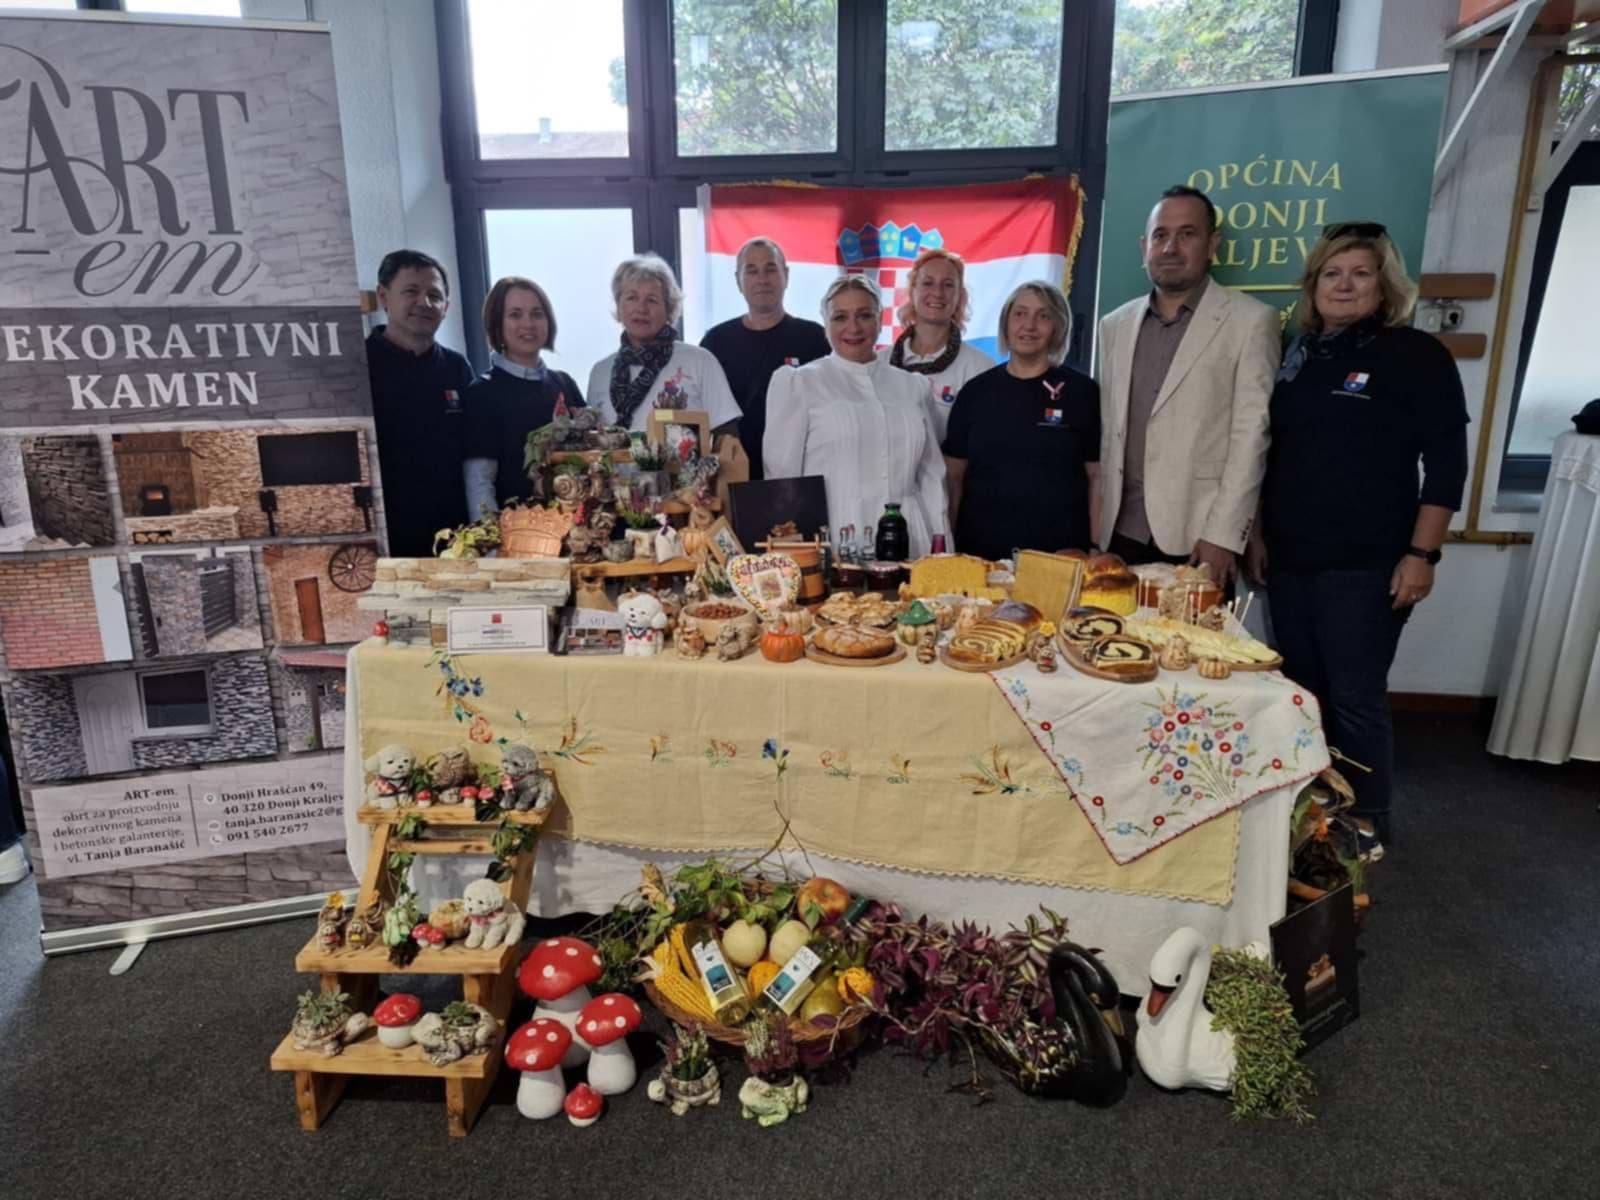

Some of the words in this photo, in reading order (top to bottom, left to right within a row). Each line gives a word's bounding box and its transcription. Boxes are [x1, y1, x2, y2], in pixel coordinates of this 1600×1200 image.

[1186, 153, 1344, 193] OPĆINA
[1, 321, 343, 362] EKORATIVNI
[66, 370, 259, 411] KAMEN
[221, 790, 255, 803] Donji
[257, 784, 306, 798] Hrašćan
[62, 811, 89, 823] obrt
[93, 810, 105, 819] za
[107, 801, 180, 819] proizvodnju
[223, 804, 239, 816] 40
[242, 802, 265, 813] 320
[268, 798, 301, 810] Donji
[52, 820, 134, 838] dekorativnog
[135, 815, 182, 827] kamena
[226, 831, 250, 842] 091
[253, 827, 276, 839] 540
[279, 822, 309, 836] 2677
[60, 836, 117, 851] betonske
[84, 850, 121, 862] Tanja
[124, 839, 186, 857] Baranašić
